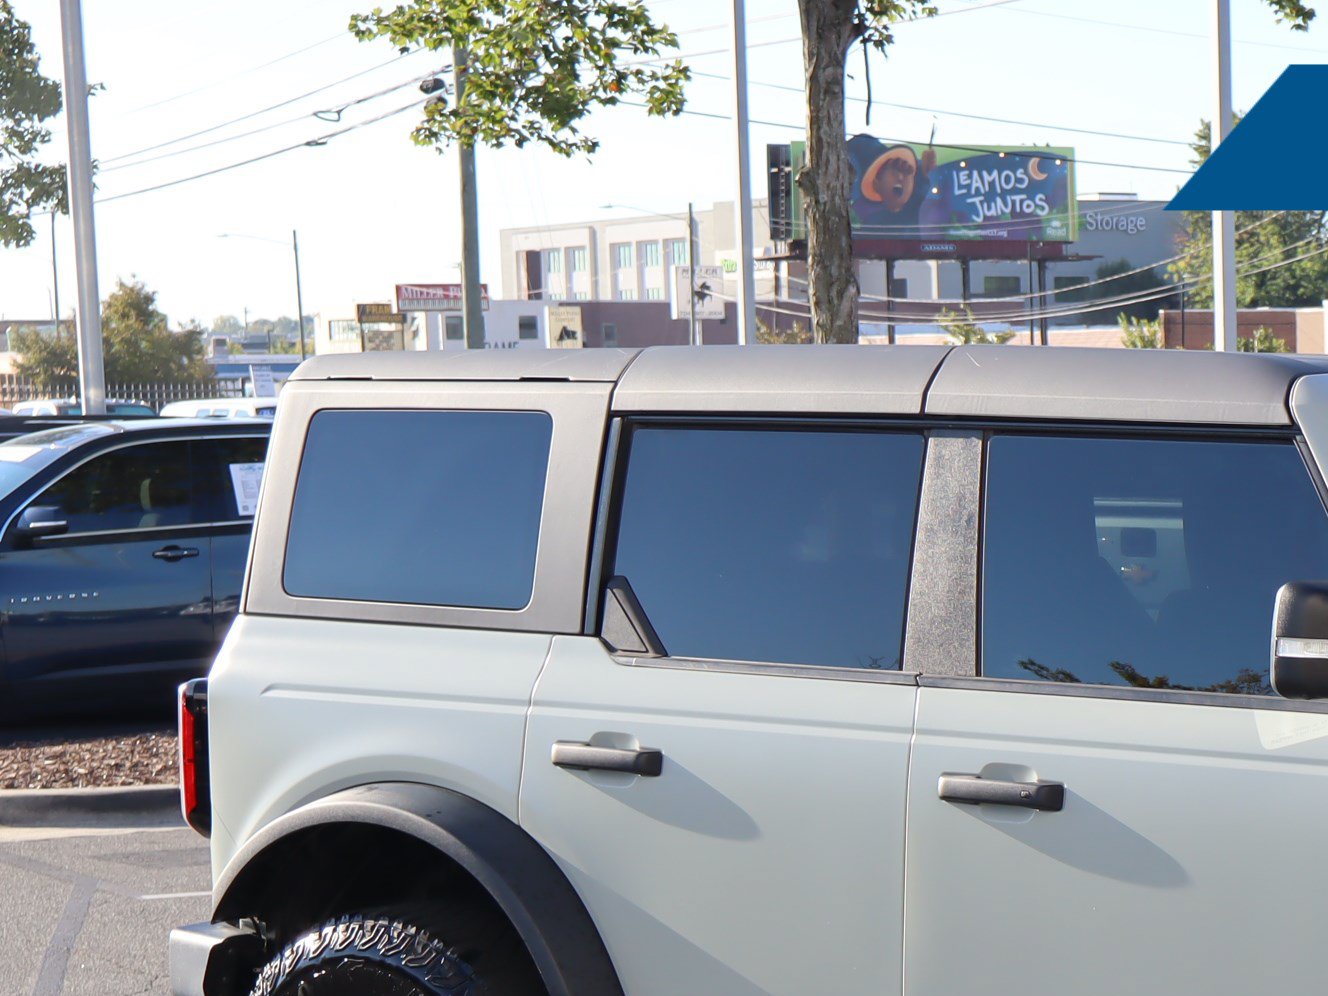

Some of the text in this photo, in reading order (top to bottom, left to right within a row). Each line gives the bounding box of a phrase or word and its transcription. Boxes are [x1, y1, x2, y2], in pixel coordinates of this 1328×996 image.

[953, 168, 1029, 196] LEAMOS
[1086, 212, 1146, 235] Storage
[402, 286, 444, 298] MILLER
